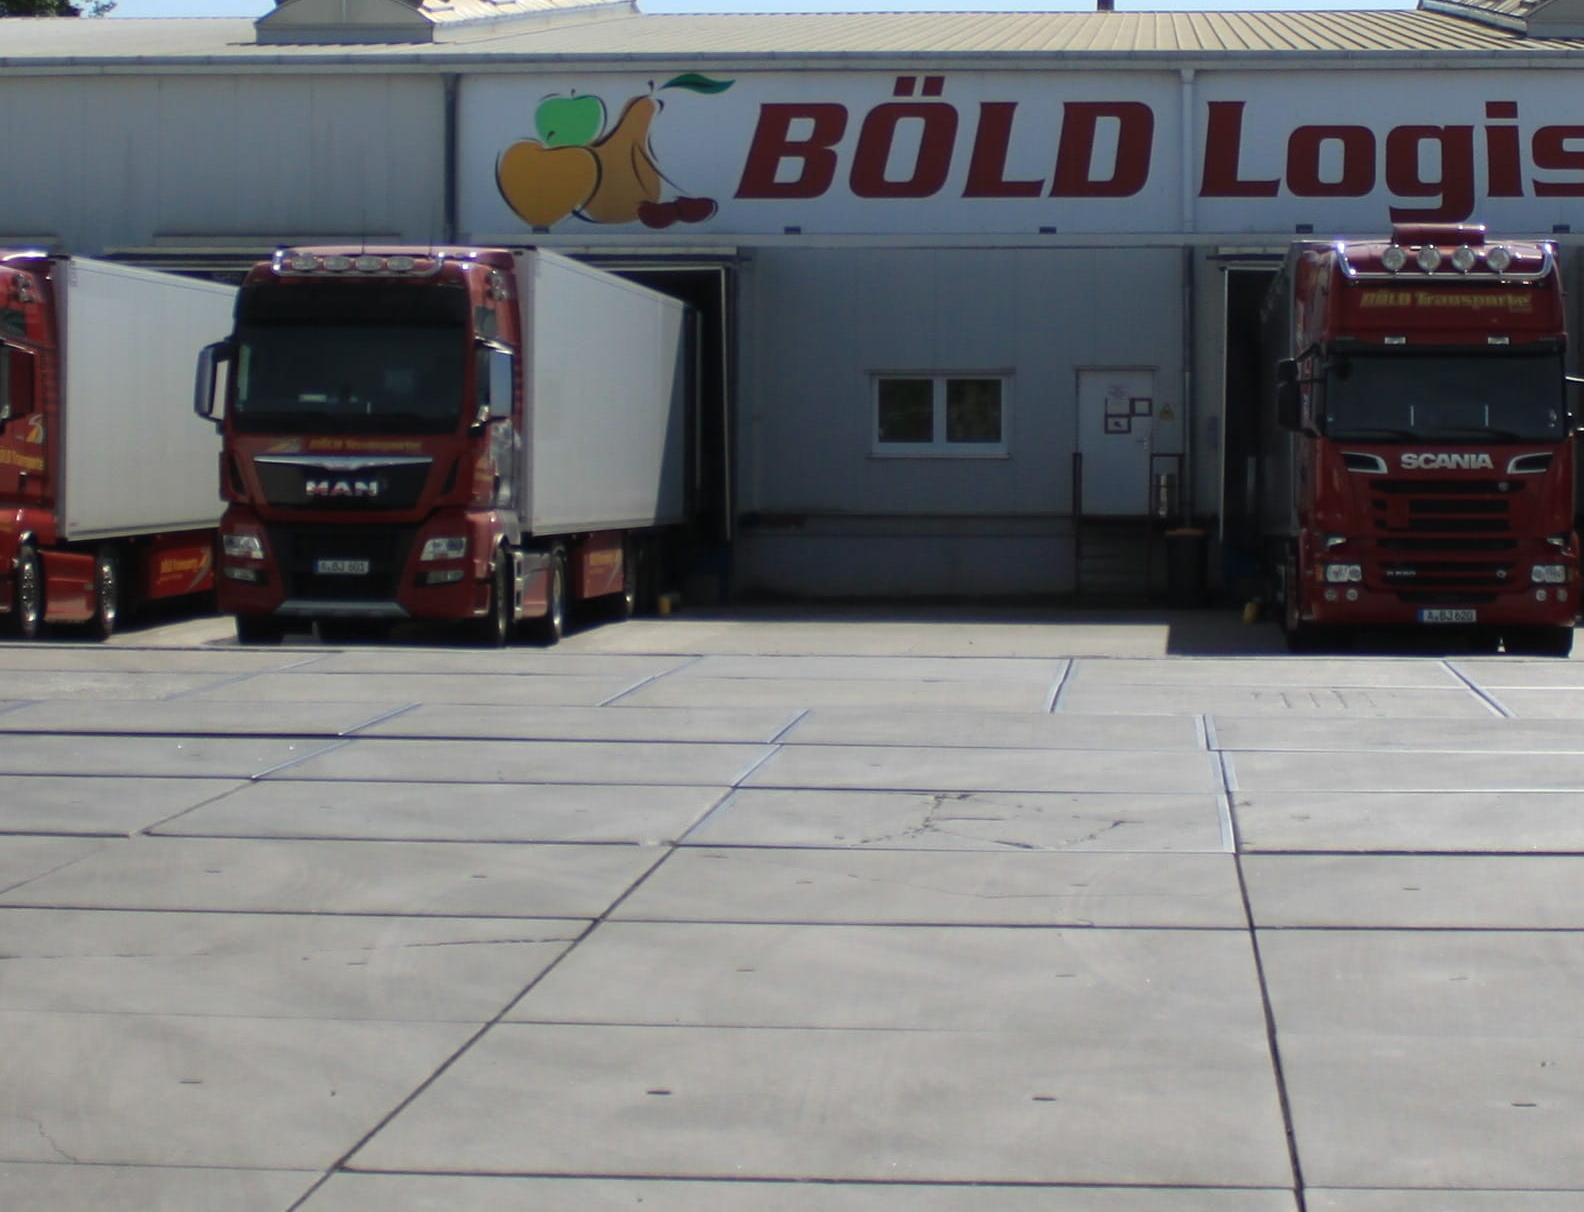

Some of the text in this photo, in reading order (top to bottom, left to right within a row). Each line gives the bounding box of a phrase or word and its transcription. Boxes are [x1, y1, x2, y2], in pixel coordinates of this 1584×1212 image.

[733, 75, 1156, 199] BÖLD
[1400, 453, 1494, 469] SCANIA
[305, 480, 378, 496] MAN
